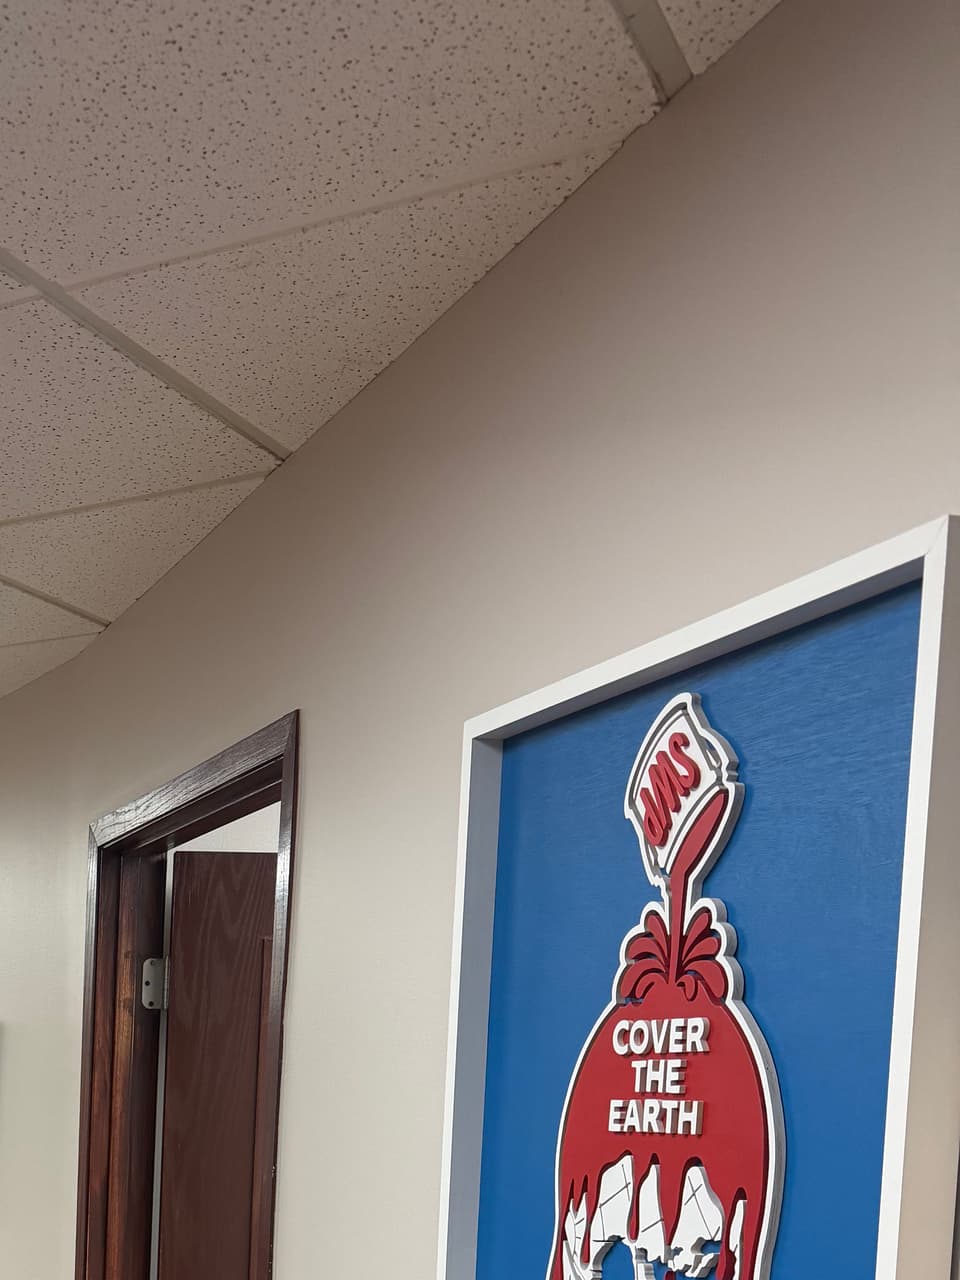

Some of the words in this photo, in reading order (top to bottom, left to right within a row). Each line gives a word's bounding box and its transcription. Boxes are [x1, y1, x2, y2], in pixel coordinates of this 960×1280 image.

[640, 732, 700, 847] SWP
[612, 1017, 708, 1056] COVER
[631, 1059, 685, 1094] THE
[608, 1099, 702, 1136] EARTH
